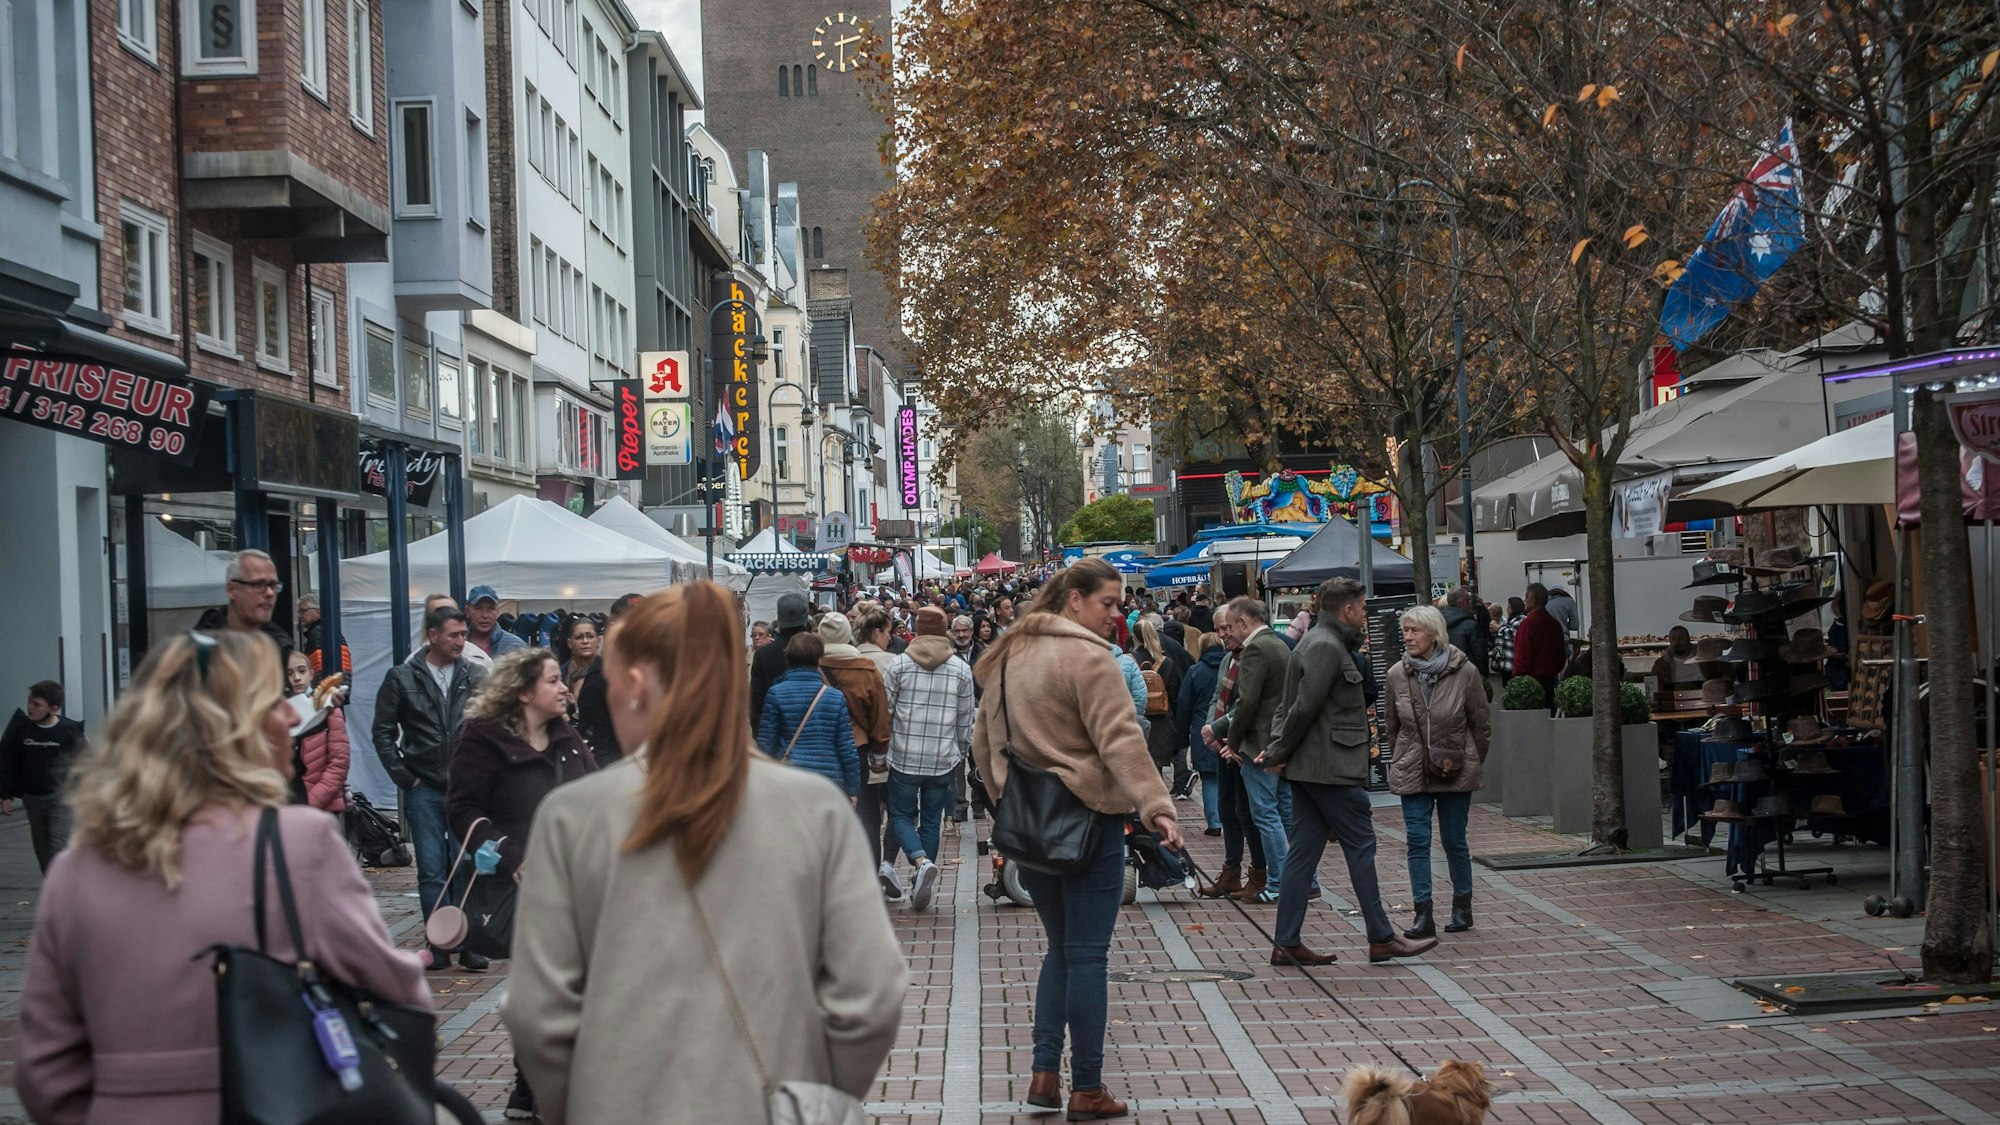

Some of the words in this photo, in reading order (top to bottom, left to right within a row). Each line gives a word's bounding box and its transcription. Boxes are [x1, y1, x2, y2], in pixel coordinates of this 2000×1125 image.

[4, 343, 194, 427] FRISEUR
[731, 282, 750, 480] bäckerei
[32, 396, 86, 430] 312
[88, 412, 143, 444] 268
[149, 427, 185, 455] 90
[618, 386, 642, 471] Pieper
[1970, 412, 2000, 437] Str
[735, 558, 819, 569] BACKFISCH
[1171, 574, 1206, 584] HOFBRÄU
